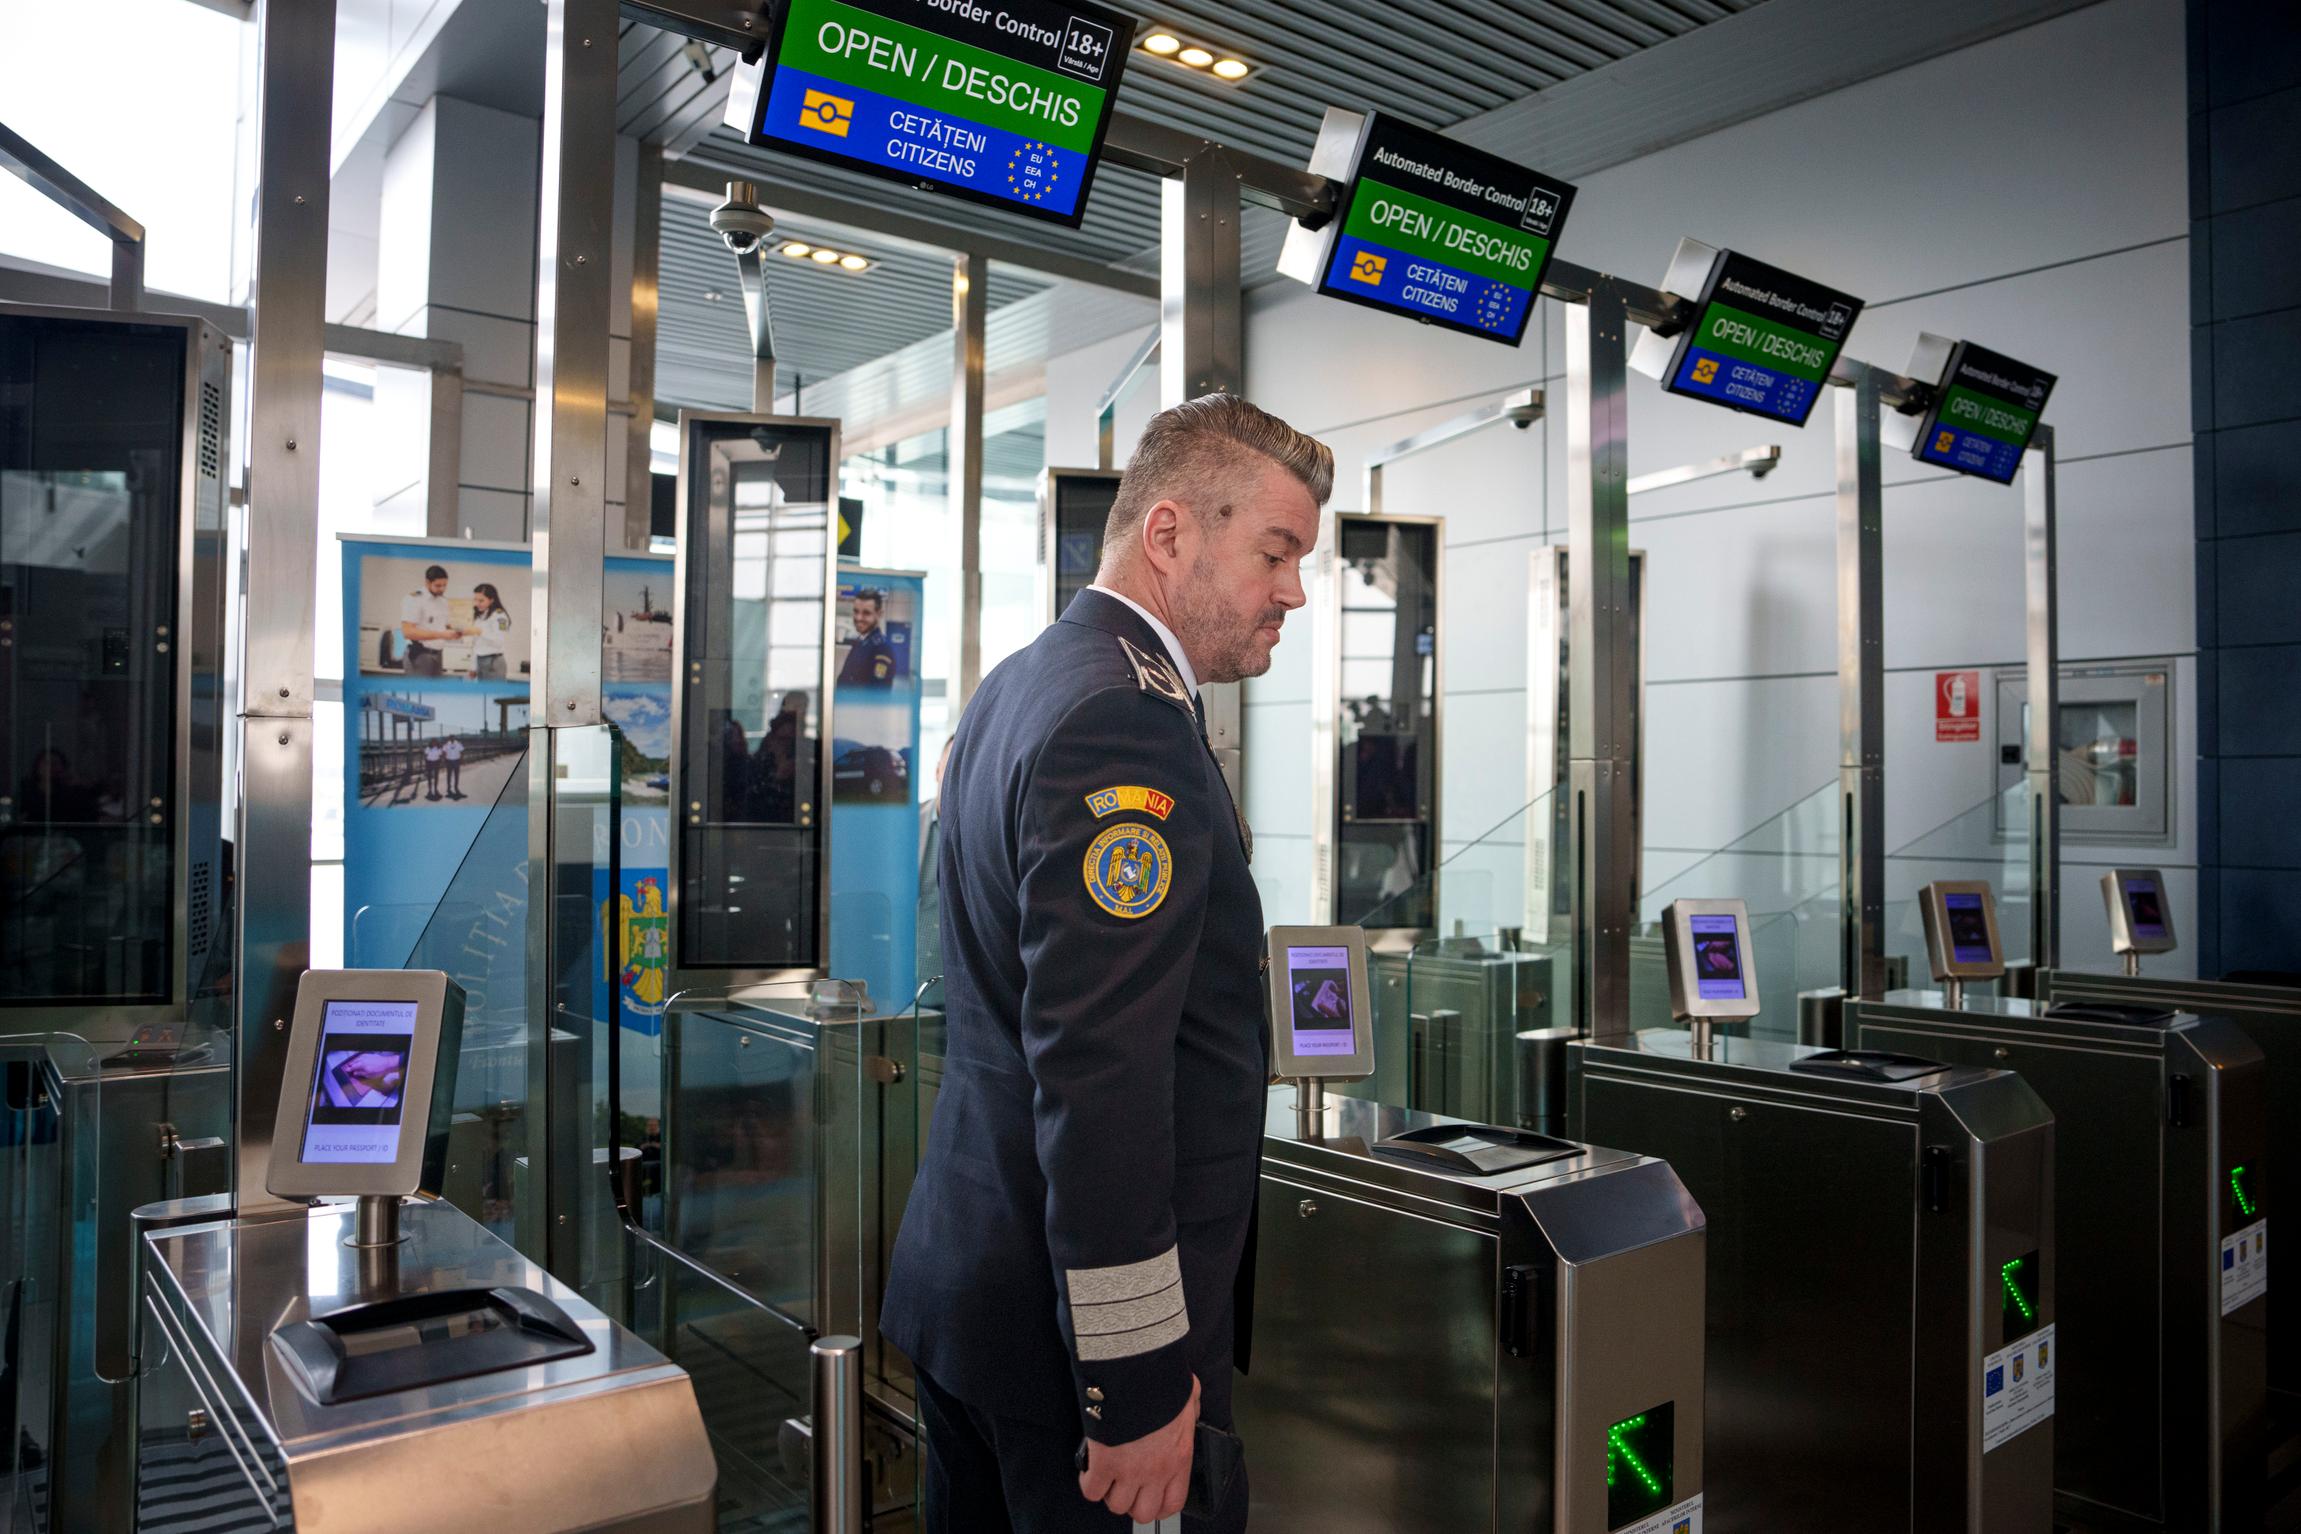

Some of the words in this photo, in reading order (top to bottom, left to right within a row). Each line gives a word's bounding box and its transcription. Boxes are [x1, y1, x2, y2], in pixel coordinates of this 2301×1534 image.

[995, 12, 1062, 48] Control
[1066, 30, 1104, 57] 18+
[818, 21, 918, 77] OPEN
[921, 53, 939, 83] /
[942, 58, 1081, 127] DESCHIS
[886, 139, 976, 178] CITIZENS
[1025, 166, 1042, 178] EEA
[1030, 152, 1043, 165] EU
[1023, 178, 1037, 190] CH
[1373, 146, 1444, 183] Automated
[1443, 171, 1485, 197] Border
[1484, 186, 1528, 213] Control
[1529, 197, 1553, 217] 18+
[1369, 200, 1433, 240] OPEN
[1432, 220, 1446, 242] /
[1444, 224, 1533, 271] DESCHIS
[1401, 285, 1459, 313] CITIZENS
[1721, 276, 1771, 303] Automated
[1768, 292, 1798, 312] Border
[1796, 303, 1828, 322] Control
[1712, 318, 1757, 347] OPEN
[1754, 331, 1765, 350] /
[1763, 333, 1825, 369] DESCHIS
[1726, 382, 1766, 404] CITIZENS
[1951, 397, 1979, 421] OPEN
[1984, 407, 2028, 435] DESCHIS
[314, 1144, 332, 1152] PLACE
[332, 1144, 348, 1152] YOUR
[349, 1144, 377, 1152] PASSPORT
